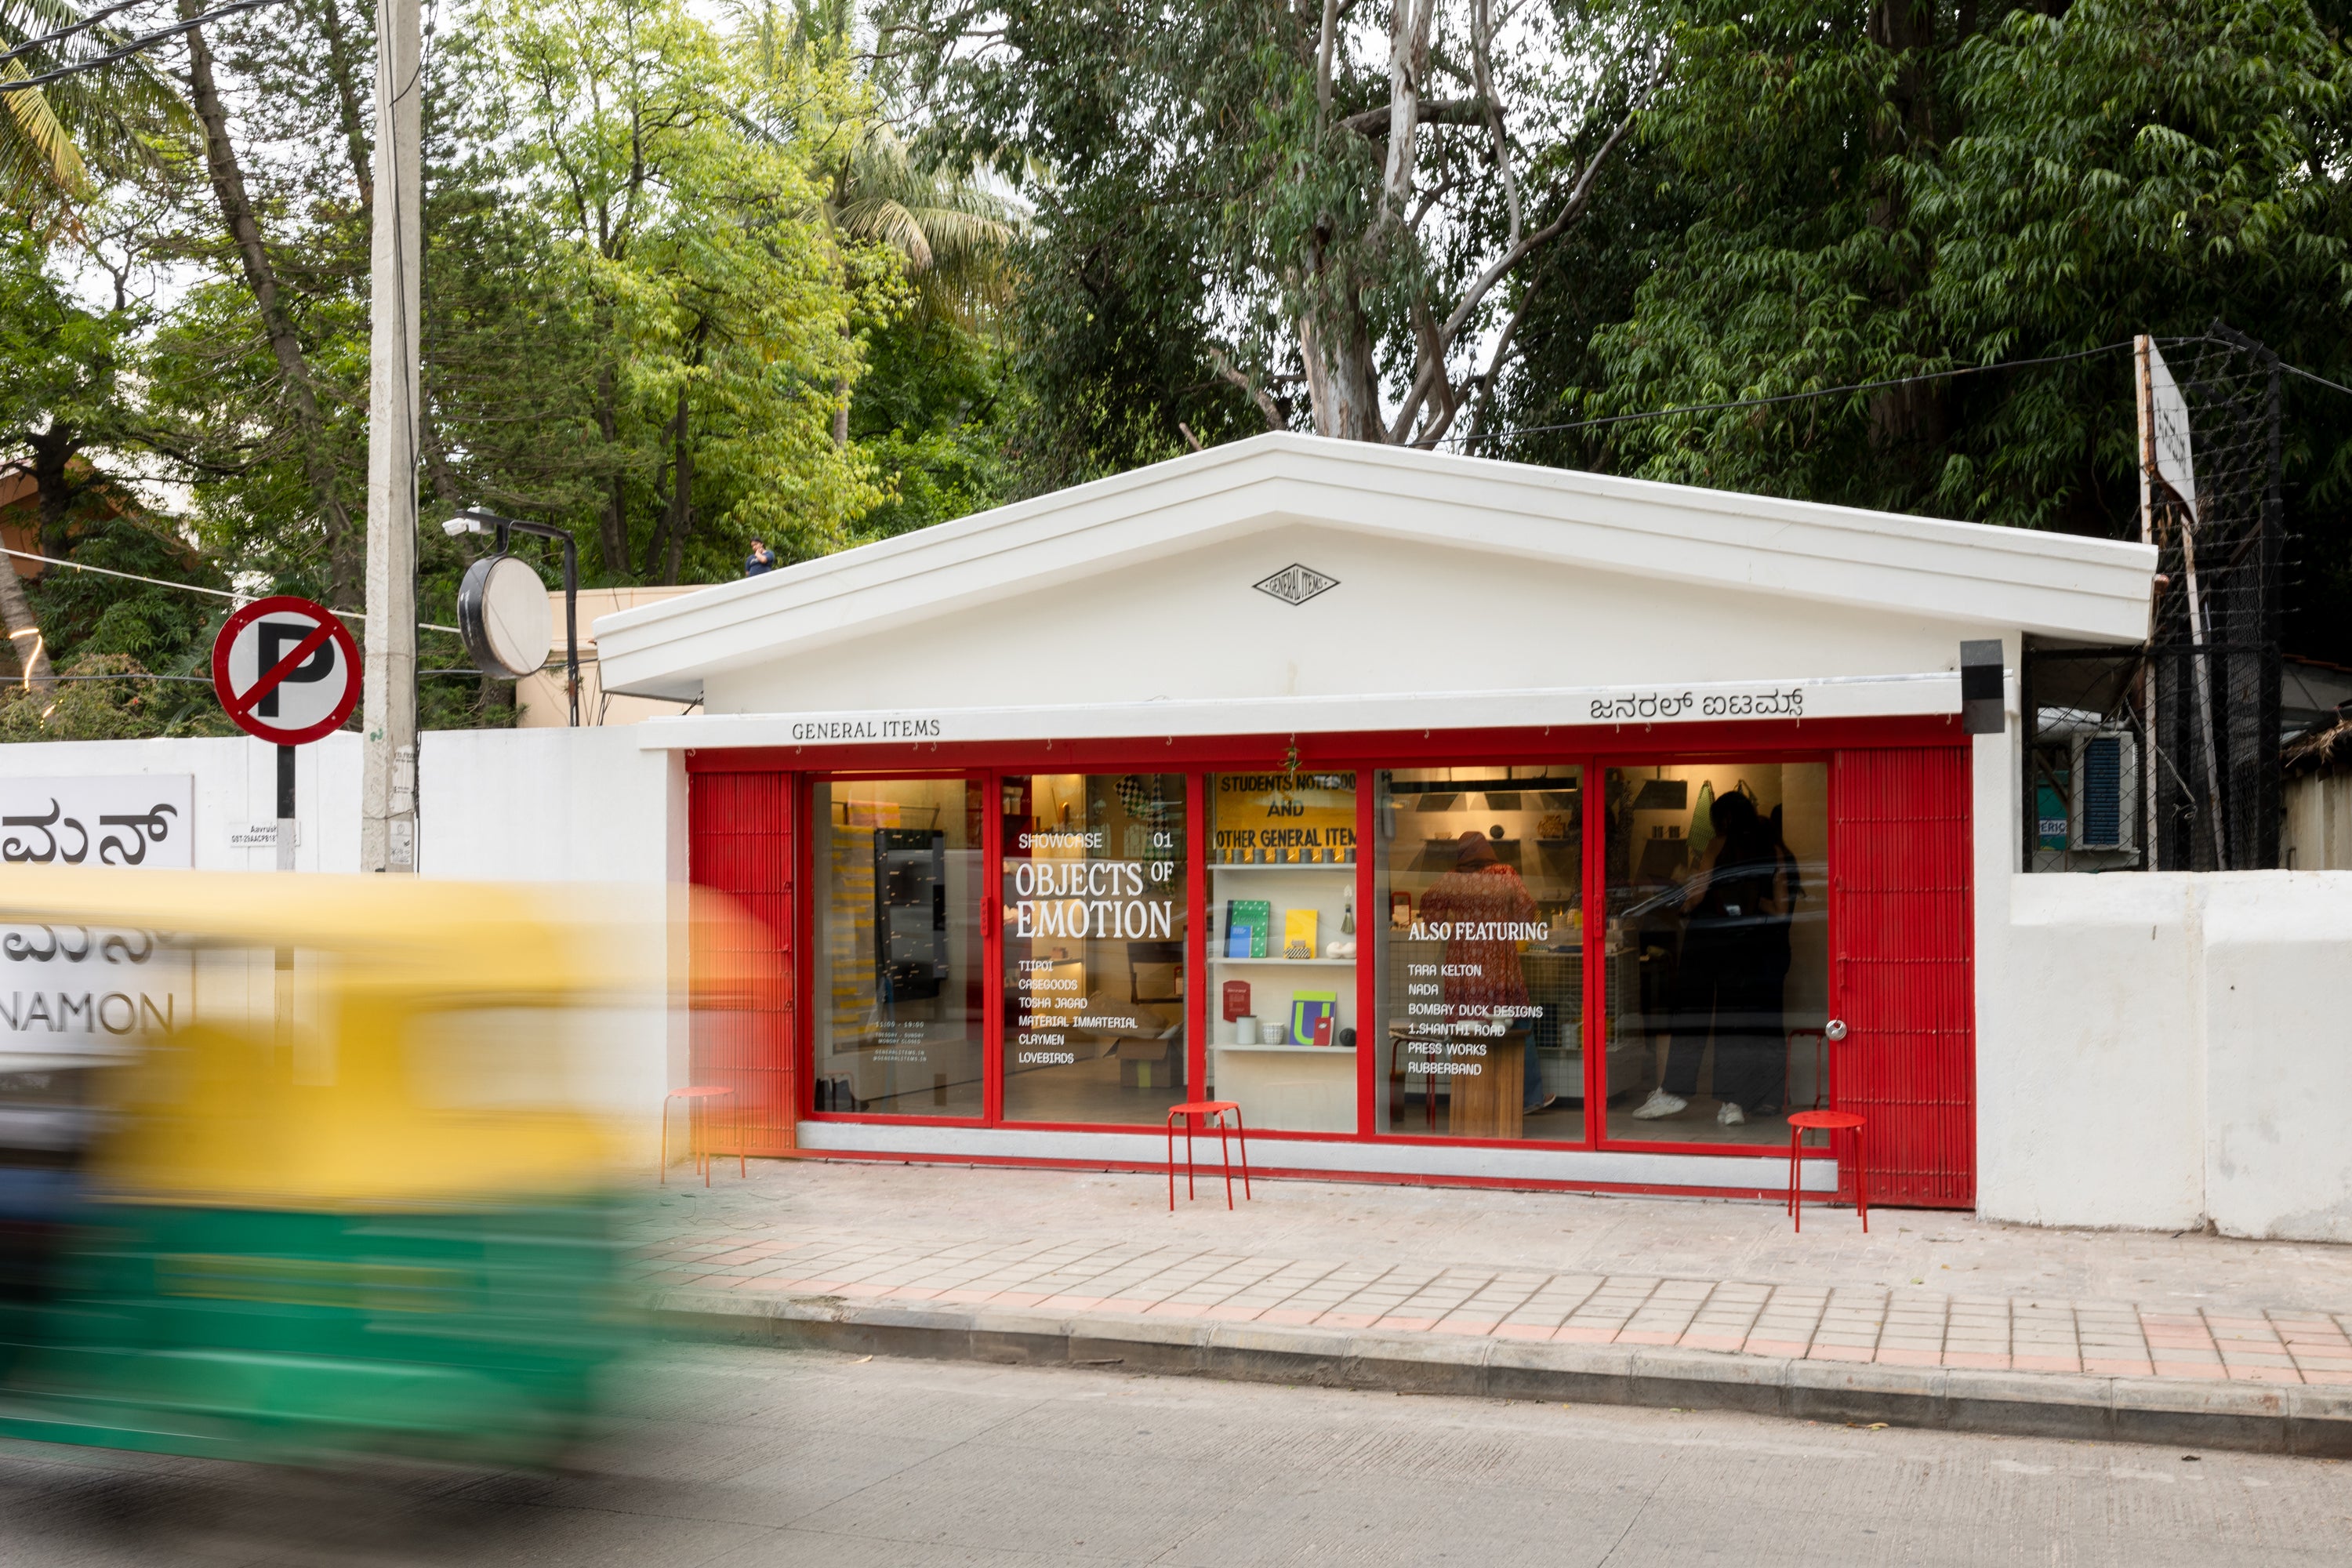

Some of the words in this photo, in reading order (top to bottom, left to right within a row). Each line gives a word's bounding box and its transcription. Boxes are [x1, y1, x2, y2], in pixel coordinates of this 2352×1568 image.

[1269, 569, 1301, 601] GENERAL
[1301, 571, 1323, 598] ITEMS
[258, 622, 336, 717] P
[1590, 691, 1693, 719] ಜನರಲ್
[1703, 688, 1803, 717] ಐಟಮ್ಸ್
[792, 721, 877, 740] GENERAL
[883, 719, 941, 737] ITEMS
[1221, 775, 1293, 792] STUDENTS
[1266, 800, 1305, 818] AND
[1018, 832, 1103, 849] SHOWCASE
[1152, 832, 1174, 848] 01
[1217, 829, 1257, 848] OTHER
[1260, 828, 1322, 848] GENERAL
[1015, 862, 1143, 896] OBJECTS
[1150, 860, 1174, 882] OF
[1016, 900, 1173, 938] EMOTION
[1408, 921, 1451, 941] ALSO
[1454, 921, 1548, 941] FEATURING
[1018, 960, 1054, 972] TIIPOI
[1407, 964, 1437, 976] TARA
[1441, 964, 1482, 977] KELTON
[1018, 978, 1078, 991] CASEGOODS
[1408, 984, 1439, 996] NADA
[1018, 997, 1052, 1009] TOSHA
[1054, 997, 1088, 1010] JAGAD
[1408, 1003, 1455, 1016] BOMBAY
[1458, 1004, 1489, 1017] DUCK
[1493, 1005, 1544, 1018] DESIGNS
[1018, 1015, 1069, 1028] MATERIAL
[1073, 1017, 1138, 1029] IMMATERIAL
[1474, 1024, 1506, 1037] ROAD
[1018, 1033, 1065, 1046] CLAYMEN
[1408, 1042, 1443, 1054] PRESS
[1446, 1043, 1487, 1056] WORKS
[1018, 1051, 1075, 1065] LOVEBIRDS
[1408, 1062, 1482, 1076] RUBBERBAND
